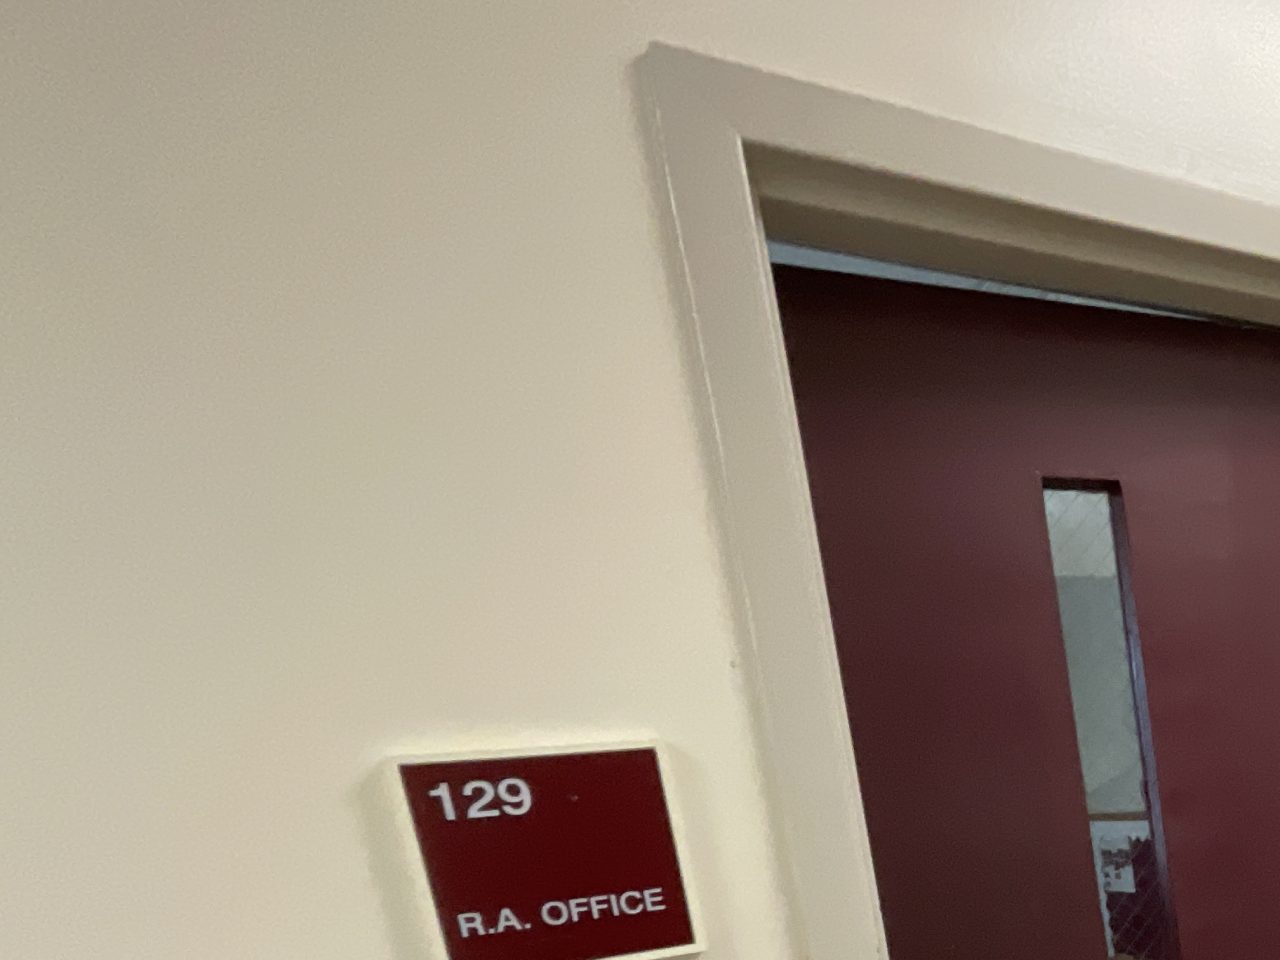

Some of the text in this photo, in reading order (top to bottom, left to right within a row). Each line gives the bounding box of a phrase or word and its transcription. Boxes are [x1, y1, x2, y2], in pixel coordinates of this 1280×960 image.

[427, 777, 533, 821] 129
[456, 887, 667, 938] R.A. OFFICE
